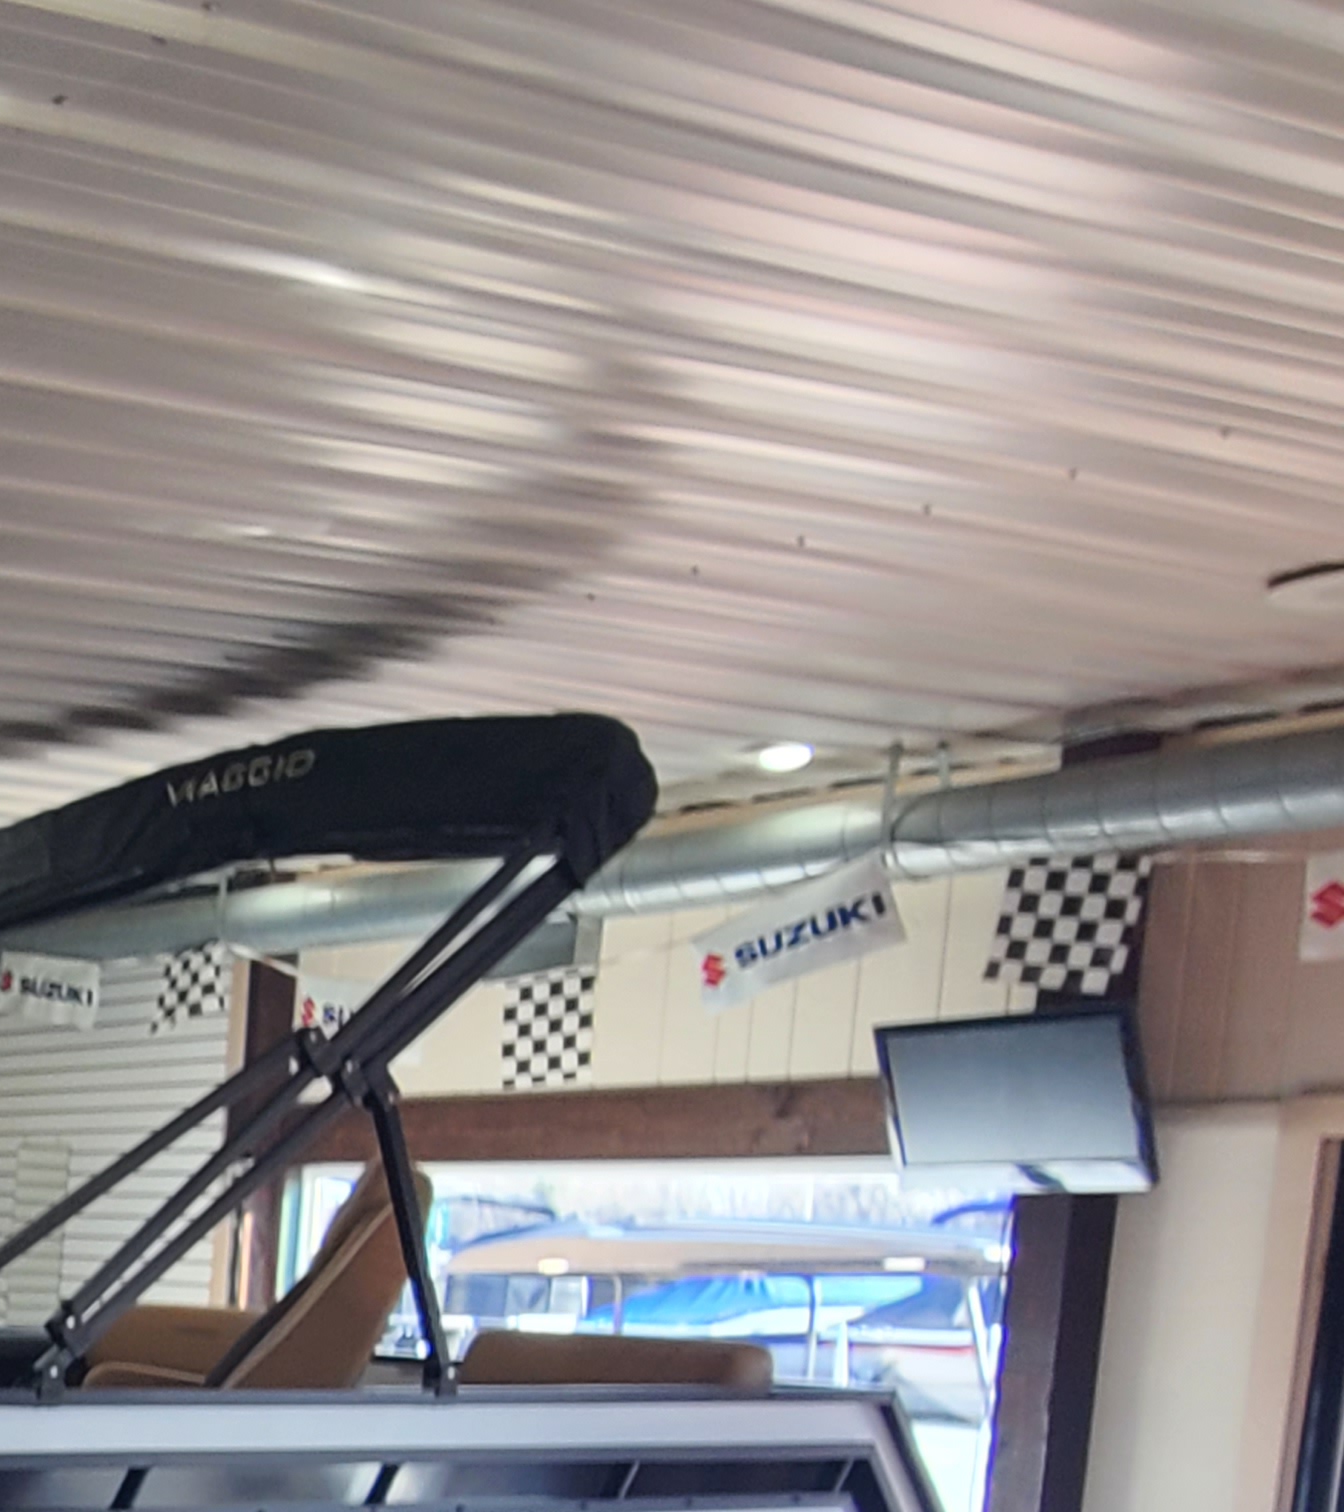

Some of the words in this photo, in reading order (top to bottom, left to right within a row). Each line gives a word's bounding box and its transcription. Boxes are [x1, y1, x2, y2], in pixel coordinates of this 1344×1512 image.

[166, 749, 316, 808] VIAGGIO
[734, 892, 886, 968] SUZUKI
[20, 978, 93, 1008] SUZUKI
